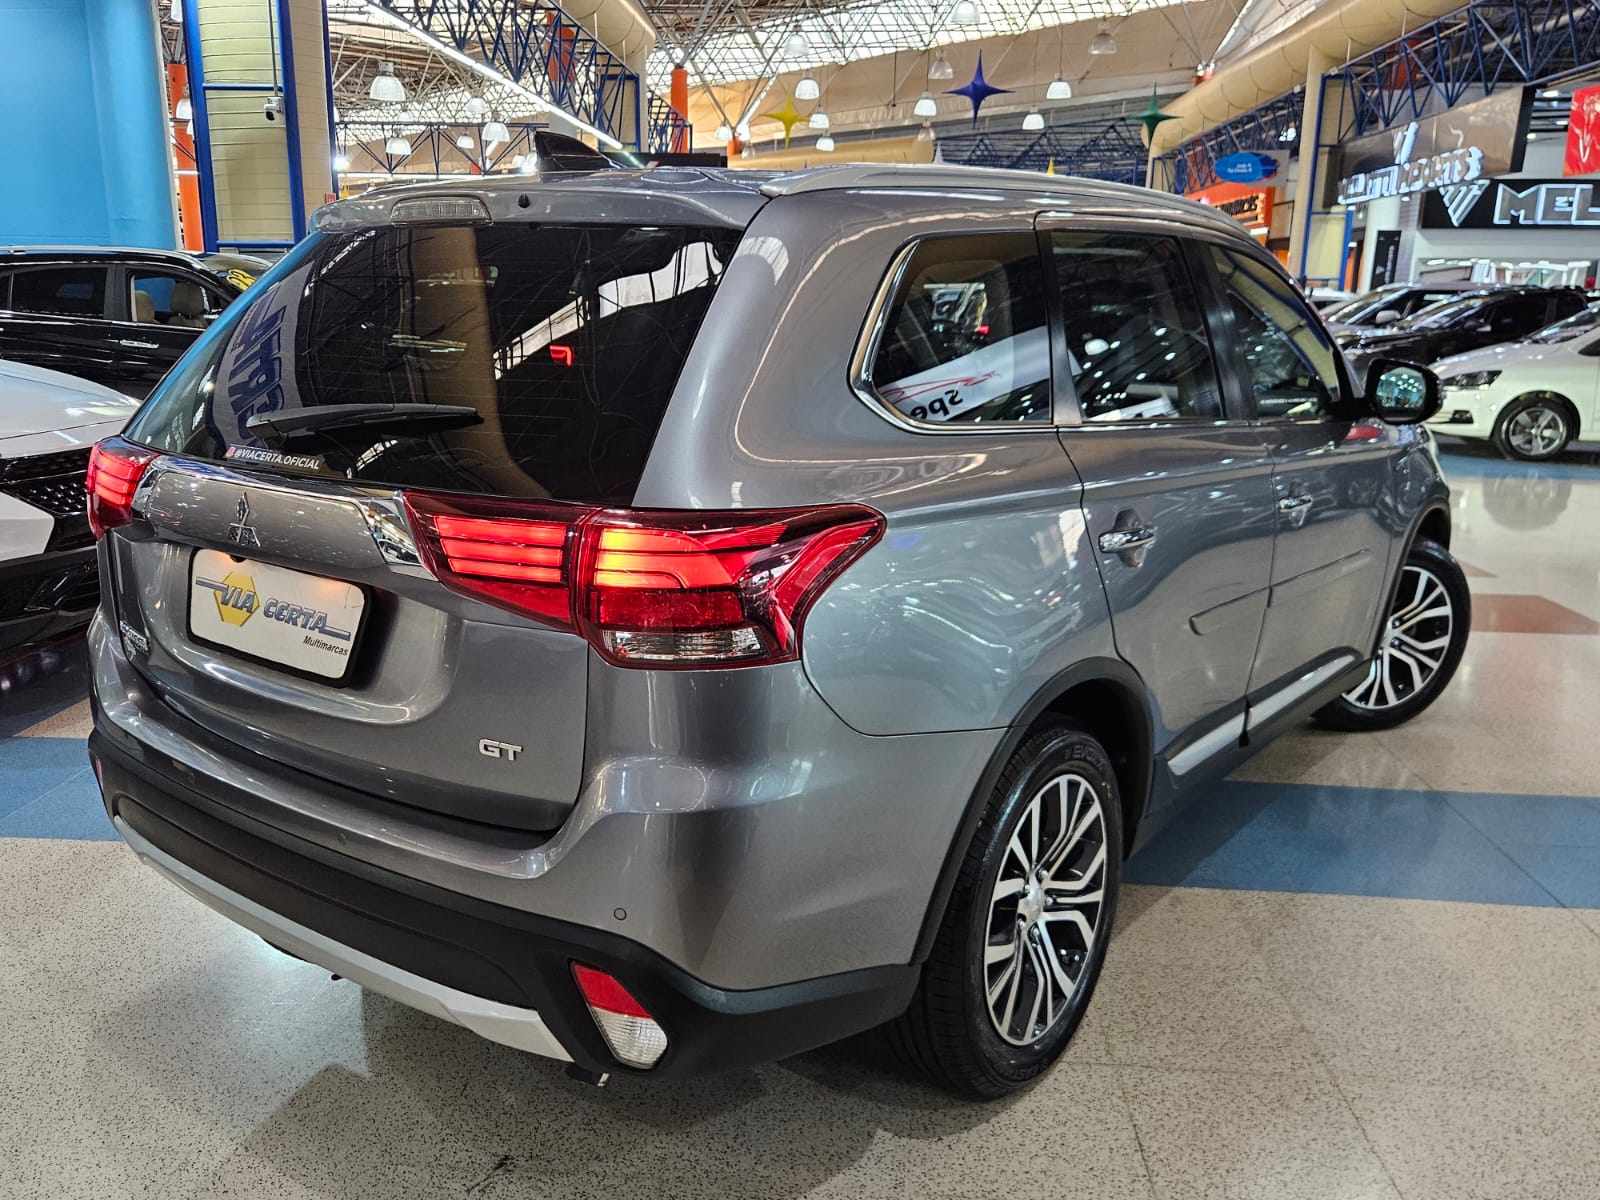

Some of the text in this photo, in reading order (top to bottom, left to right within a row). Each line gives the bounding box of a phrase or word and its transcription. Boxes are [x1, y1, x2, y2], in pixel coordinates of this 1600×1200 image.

[233, 448, 320, 470] @VIACERTA.OFICIAL
[220, 584, 328, 634] VIA CERTA
[303, 635, 349, 656] Multimarcas
[479, 739, 523, 761] GT
